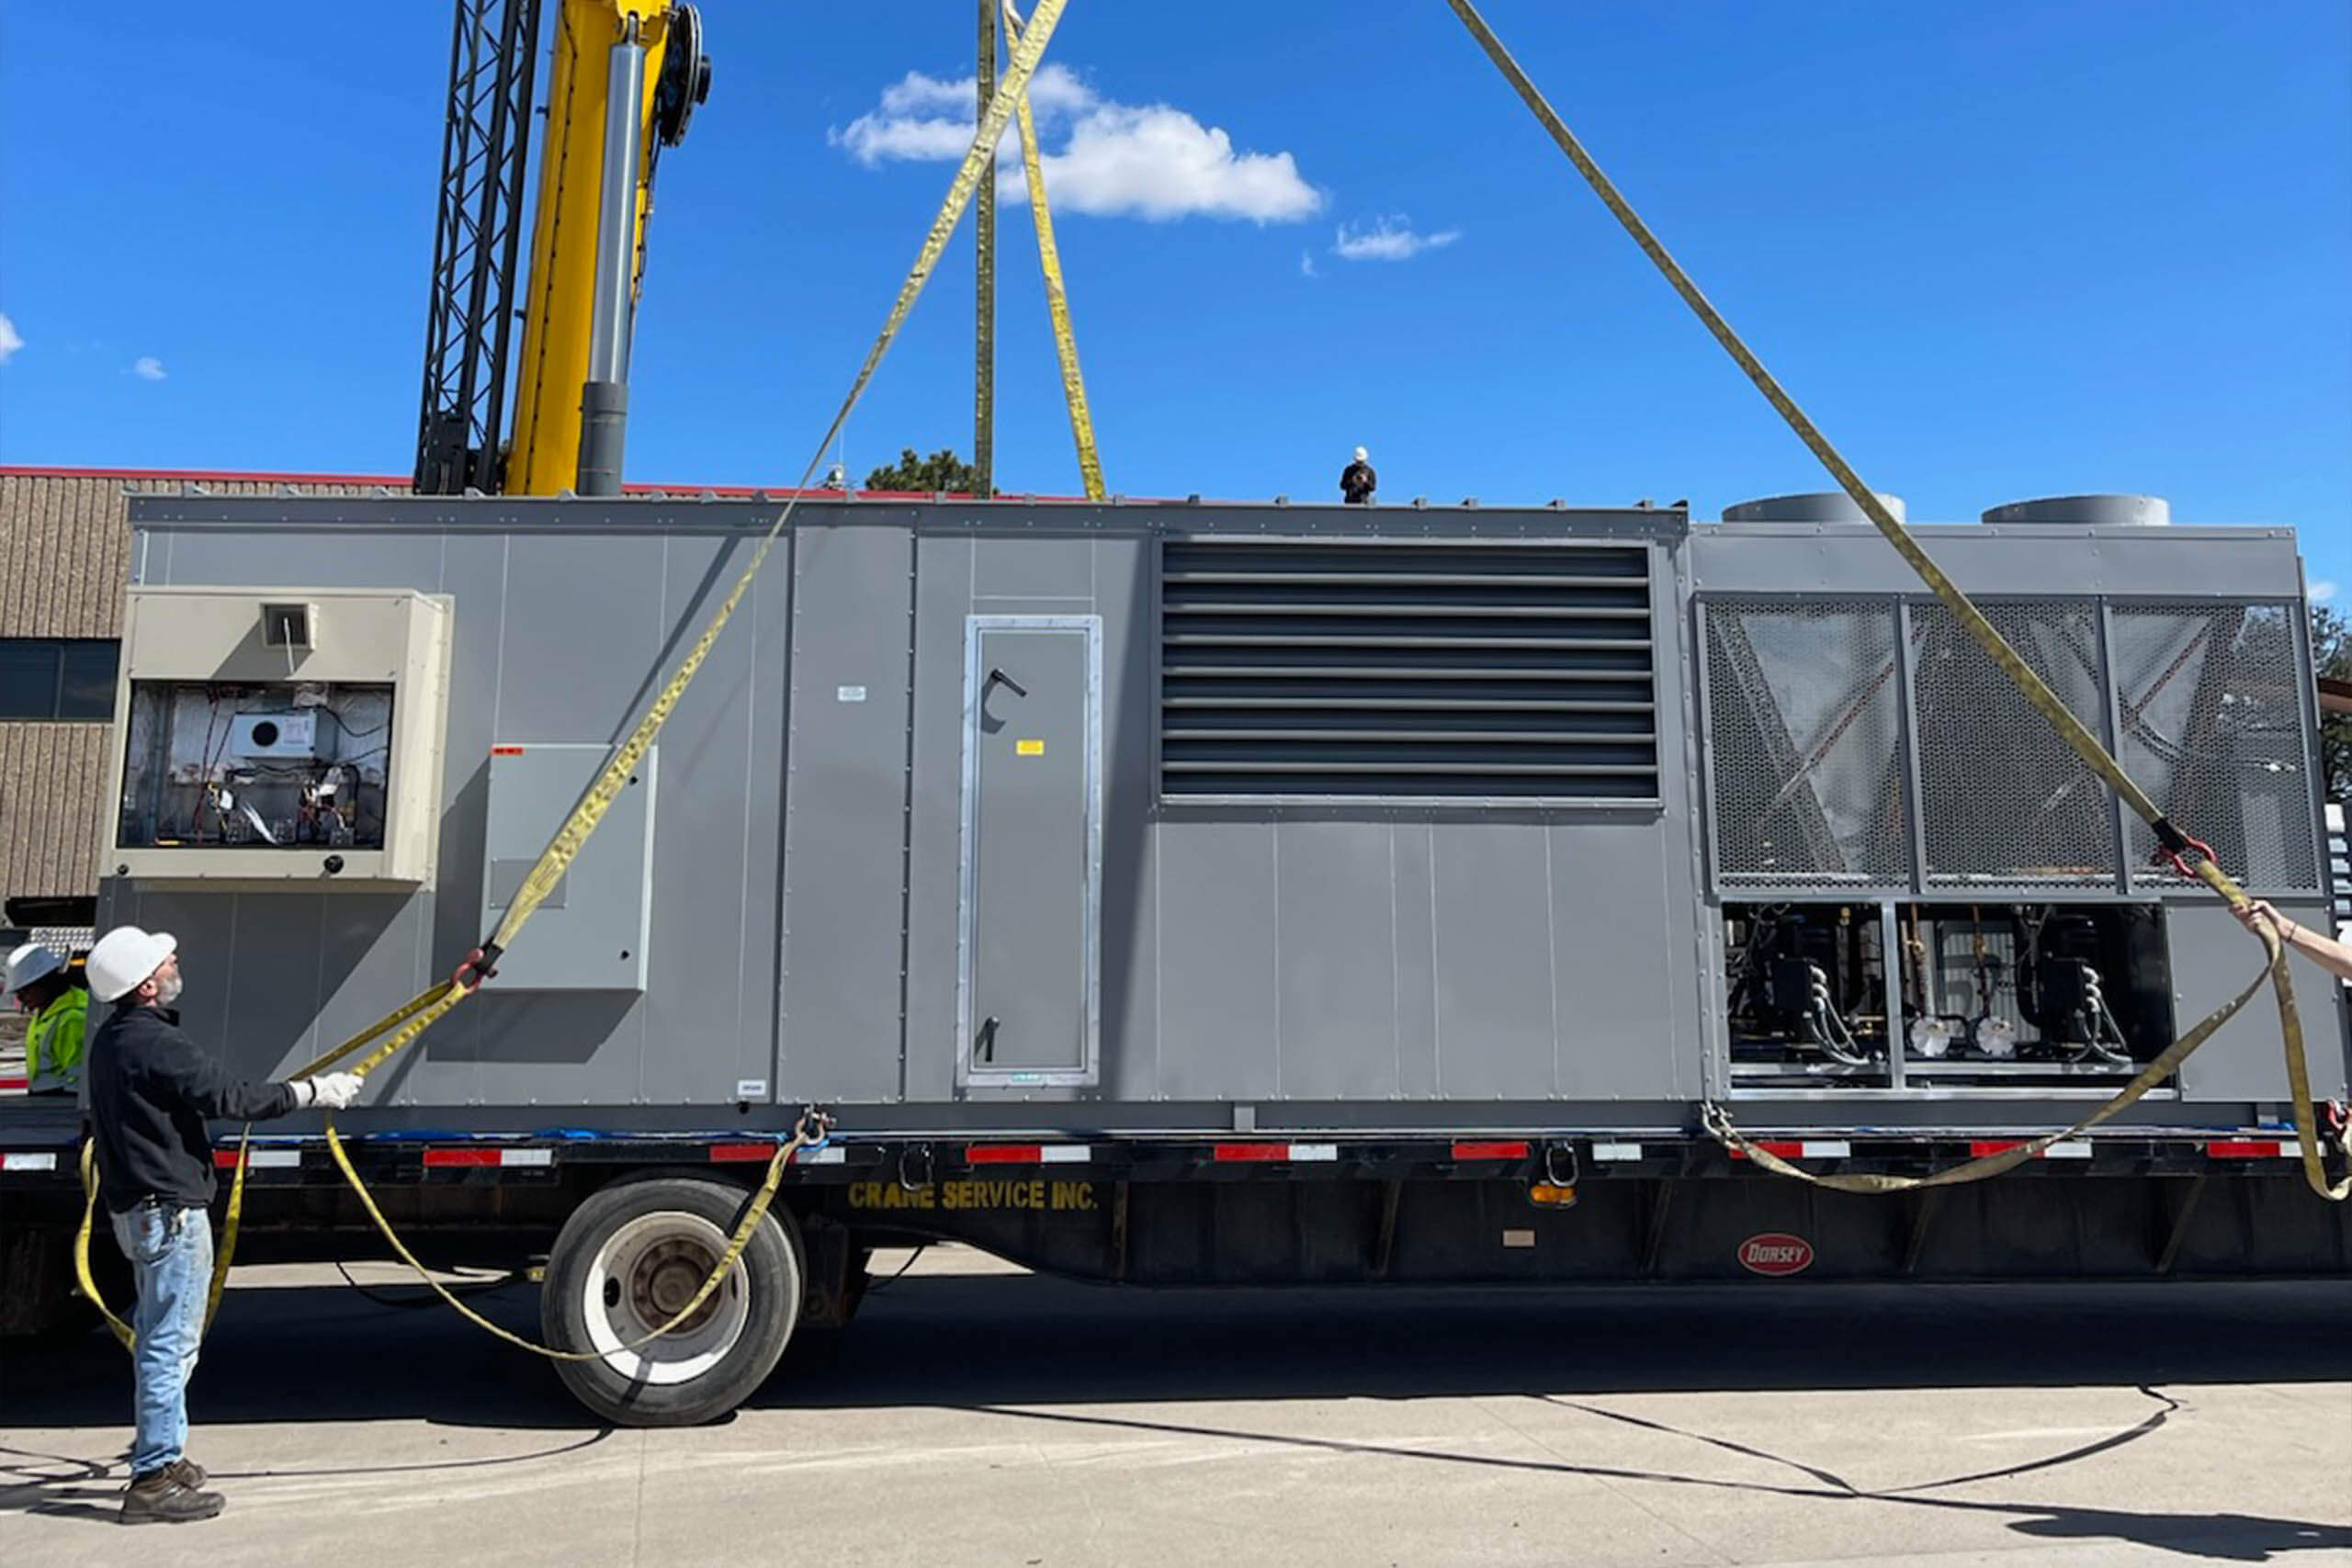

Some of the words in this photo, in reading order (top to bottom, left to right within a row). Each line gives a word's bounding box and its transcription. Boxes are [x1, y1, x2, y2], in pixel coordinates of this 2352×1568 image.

[848, 1181, 936, 1209] CRANE
[942, 1181, 1046, 1209] SERVICE
[1050, 1181, 1099, 1210] INC.
